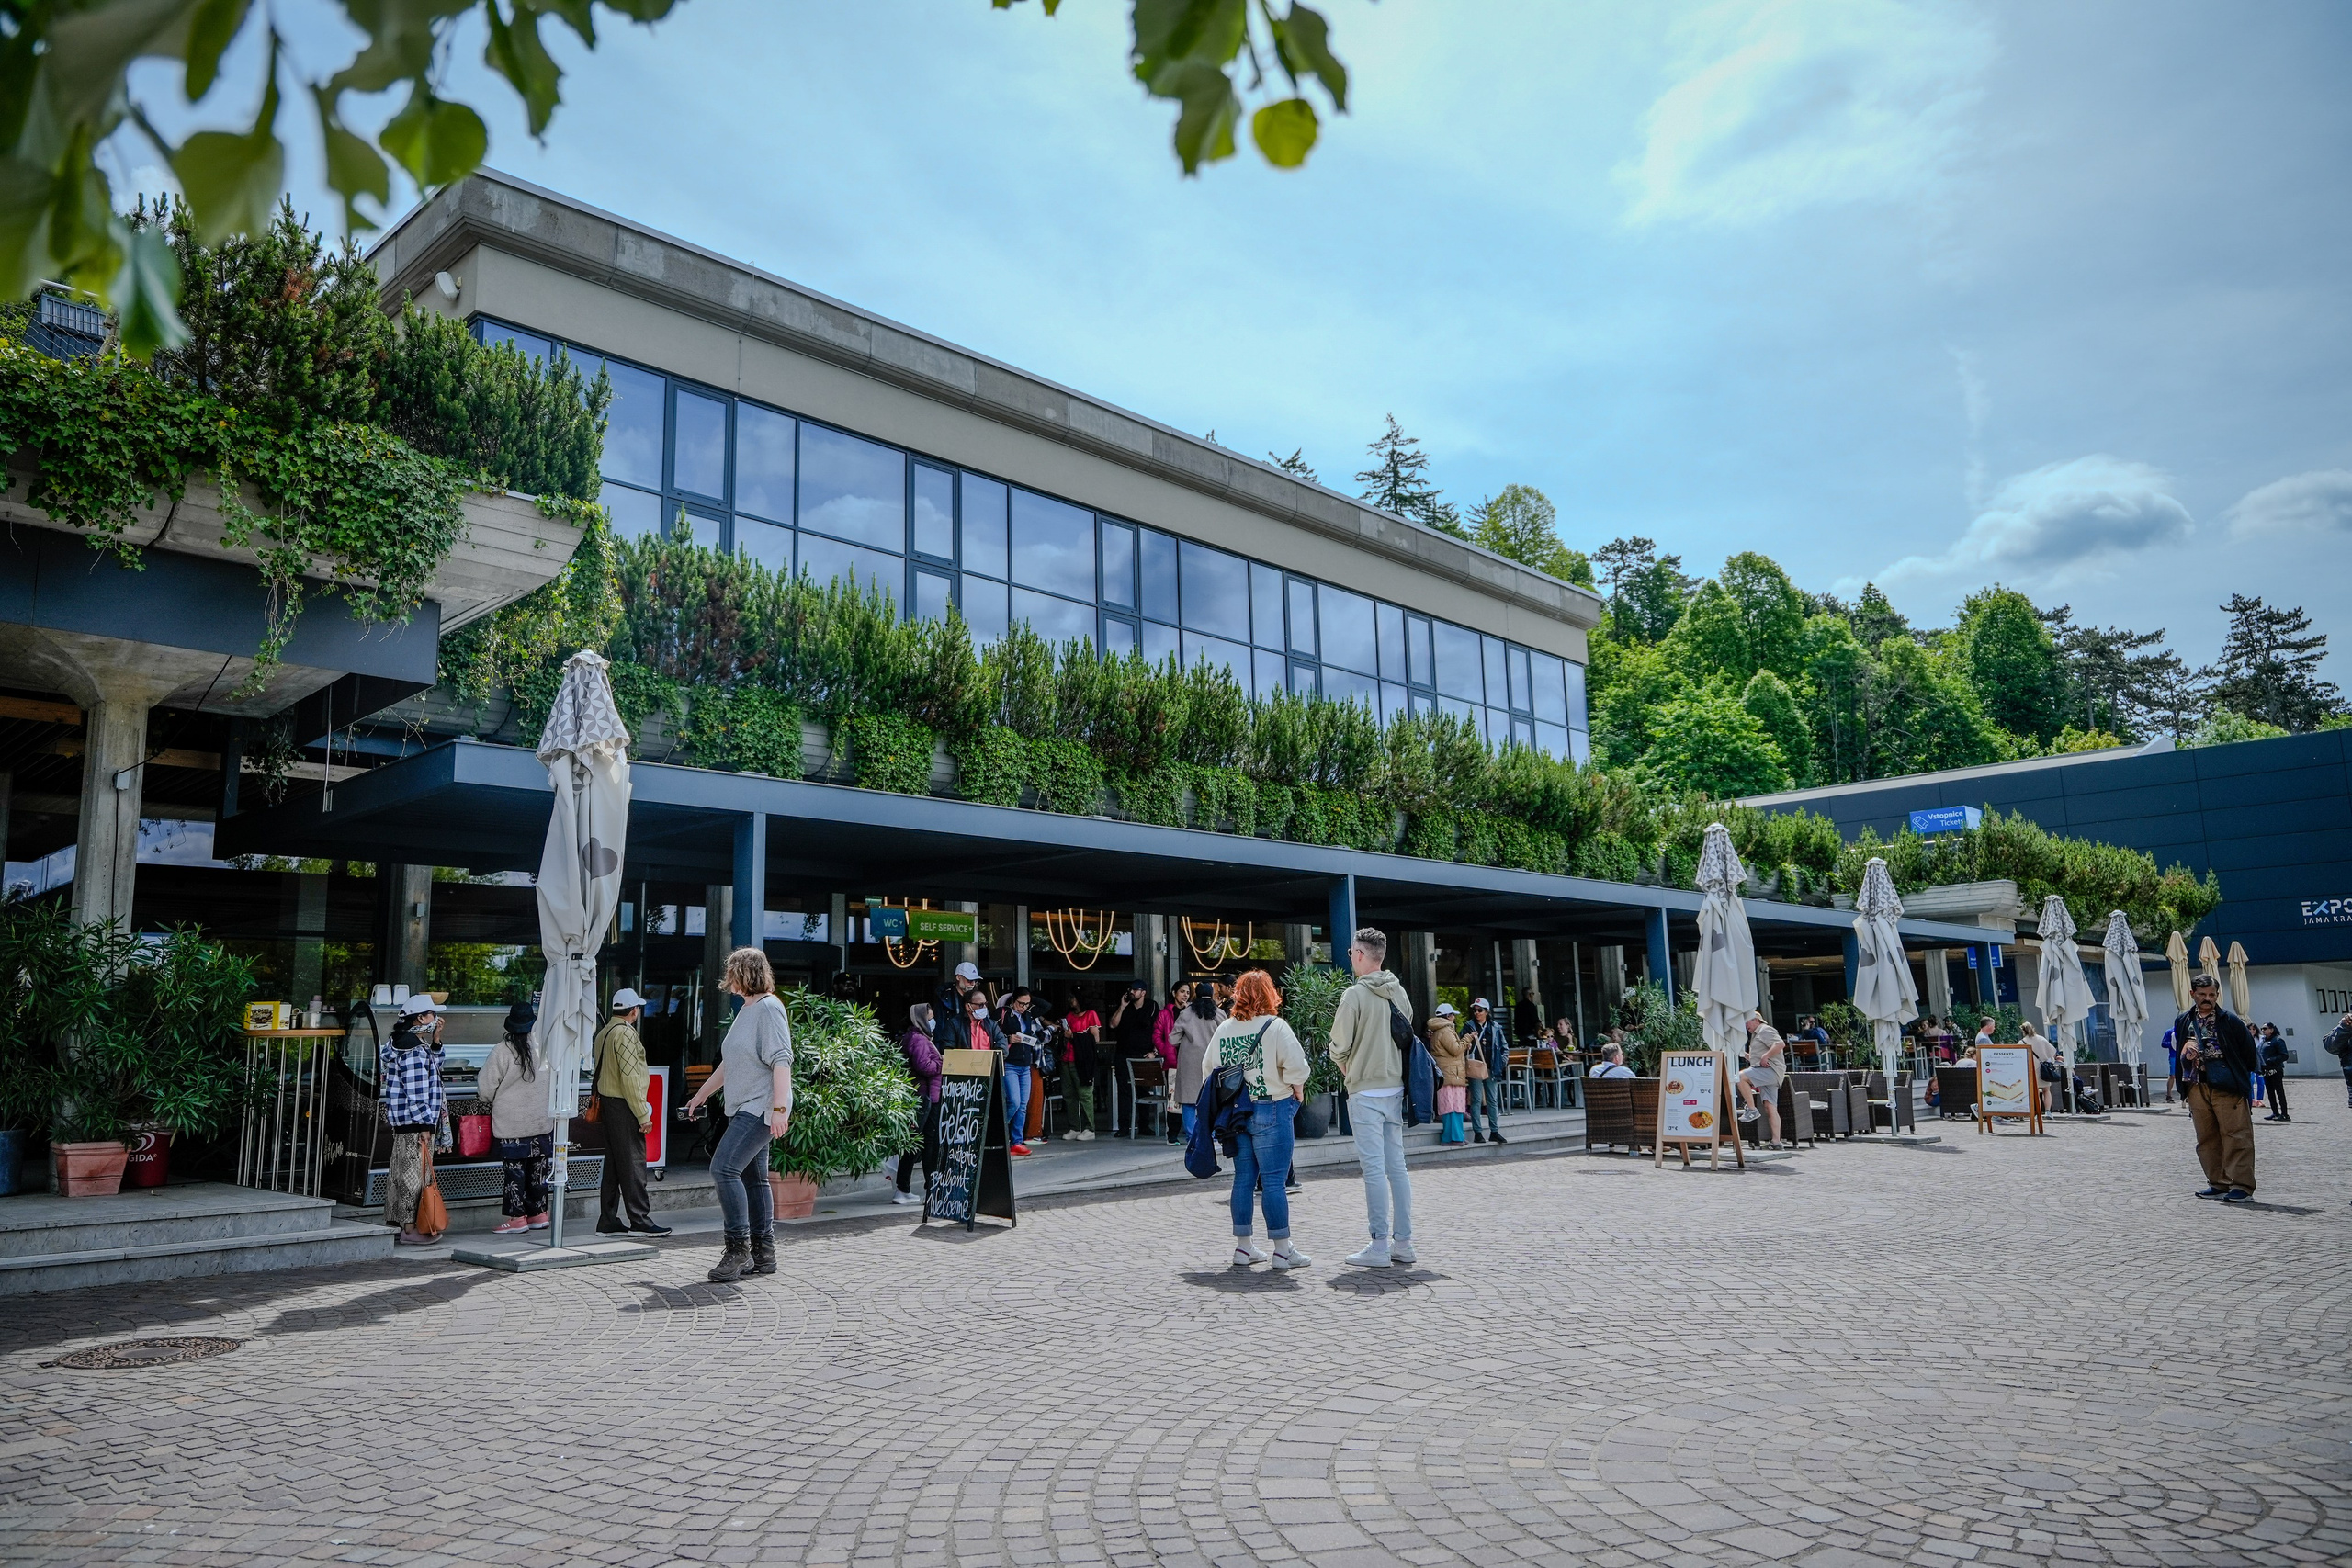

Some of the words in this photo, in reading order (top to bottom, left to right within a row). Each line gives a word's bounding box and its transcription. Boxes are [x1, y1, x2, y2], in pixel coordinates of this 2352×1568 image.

[1928, 811, 1963, 820] Vstopnice
[1940, 818, 1964, 827] Tickets
[883, 919, 899, 928] WC
[2303, 917, 2330, 926] JAMA
[2333, 915, 2352, 923] KRA
[920, 922, 937, 931] SELF
[938, 923, 968, 933] SERVICE
[1670, 1056, 1713, 1067] LUNCH
[128, 1154, 154, 1162] GIDA
